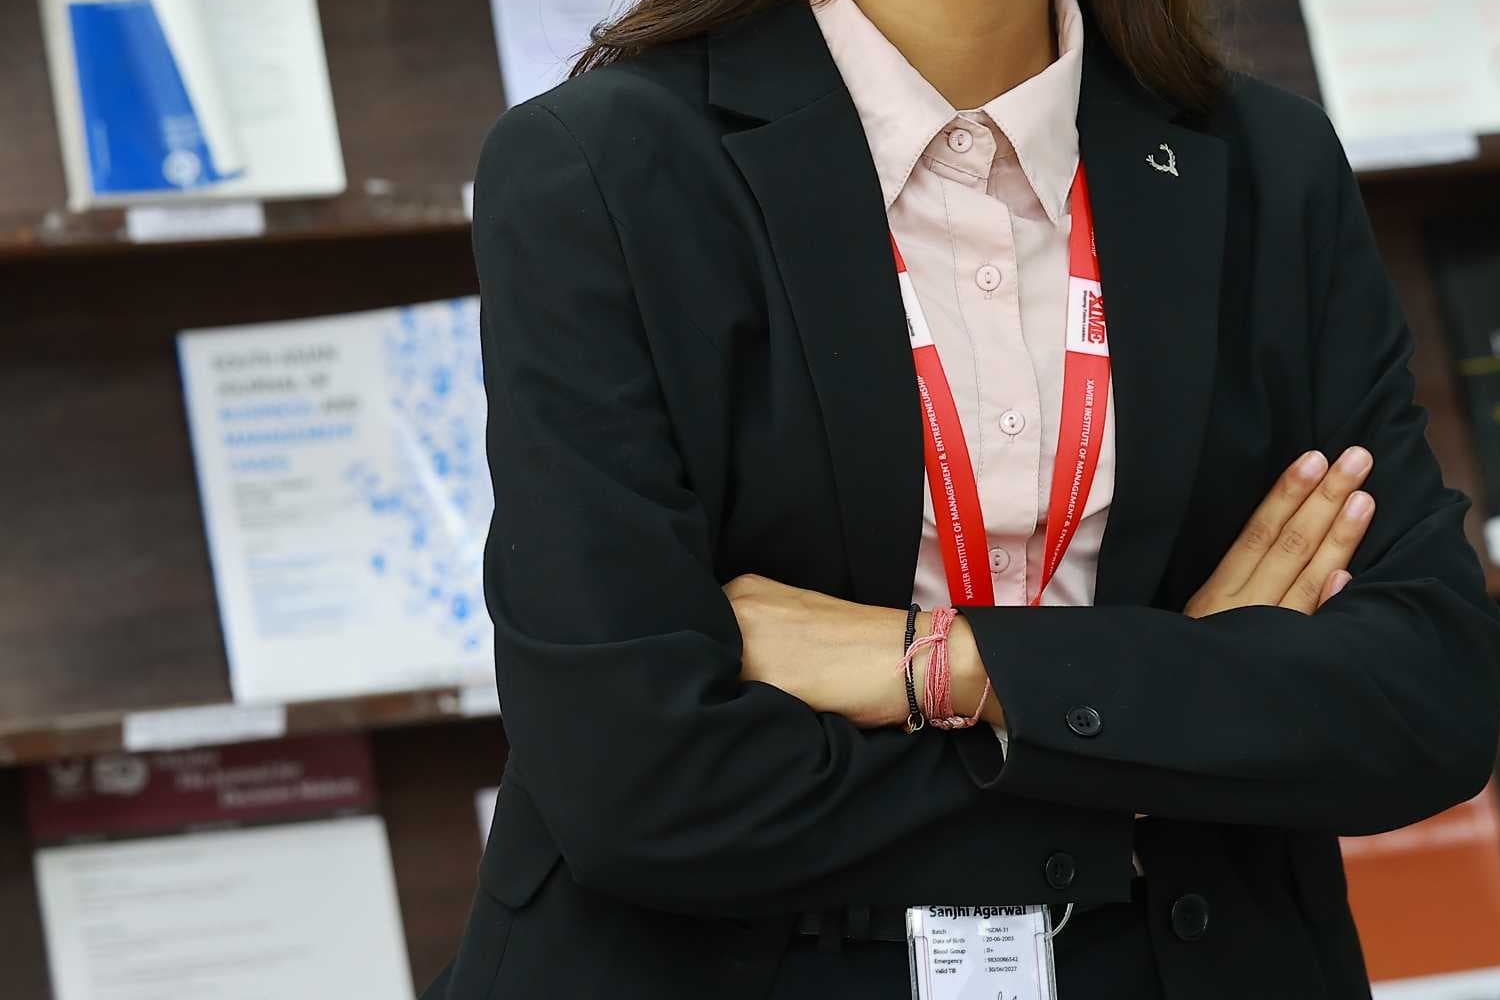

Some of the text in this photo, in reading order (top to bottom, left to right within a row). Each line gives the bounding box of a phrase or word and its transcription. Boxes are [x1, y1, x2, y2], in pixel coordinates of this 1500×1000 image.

[1088, 290, 1105, 344] XIME
[1064, 379, 1095, 527] XAVIER INSTITUTE OF MANAGEMENT &
[941, 462, 961, 521] MANAGEMENT
[952, 521, 962, 532] OF
[955, 534, 970, 573] INSTITUTE
[962, 573, 975, 600] XAVIER
[928, 906, 1026, 920] Sanjhi Agarwal
